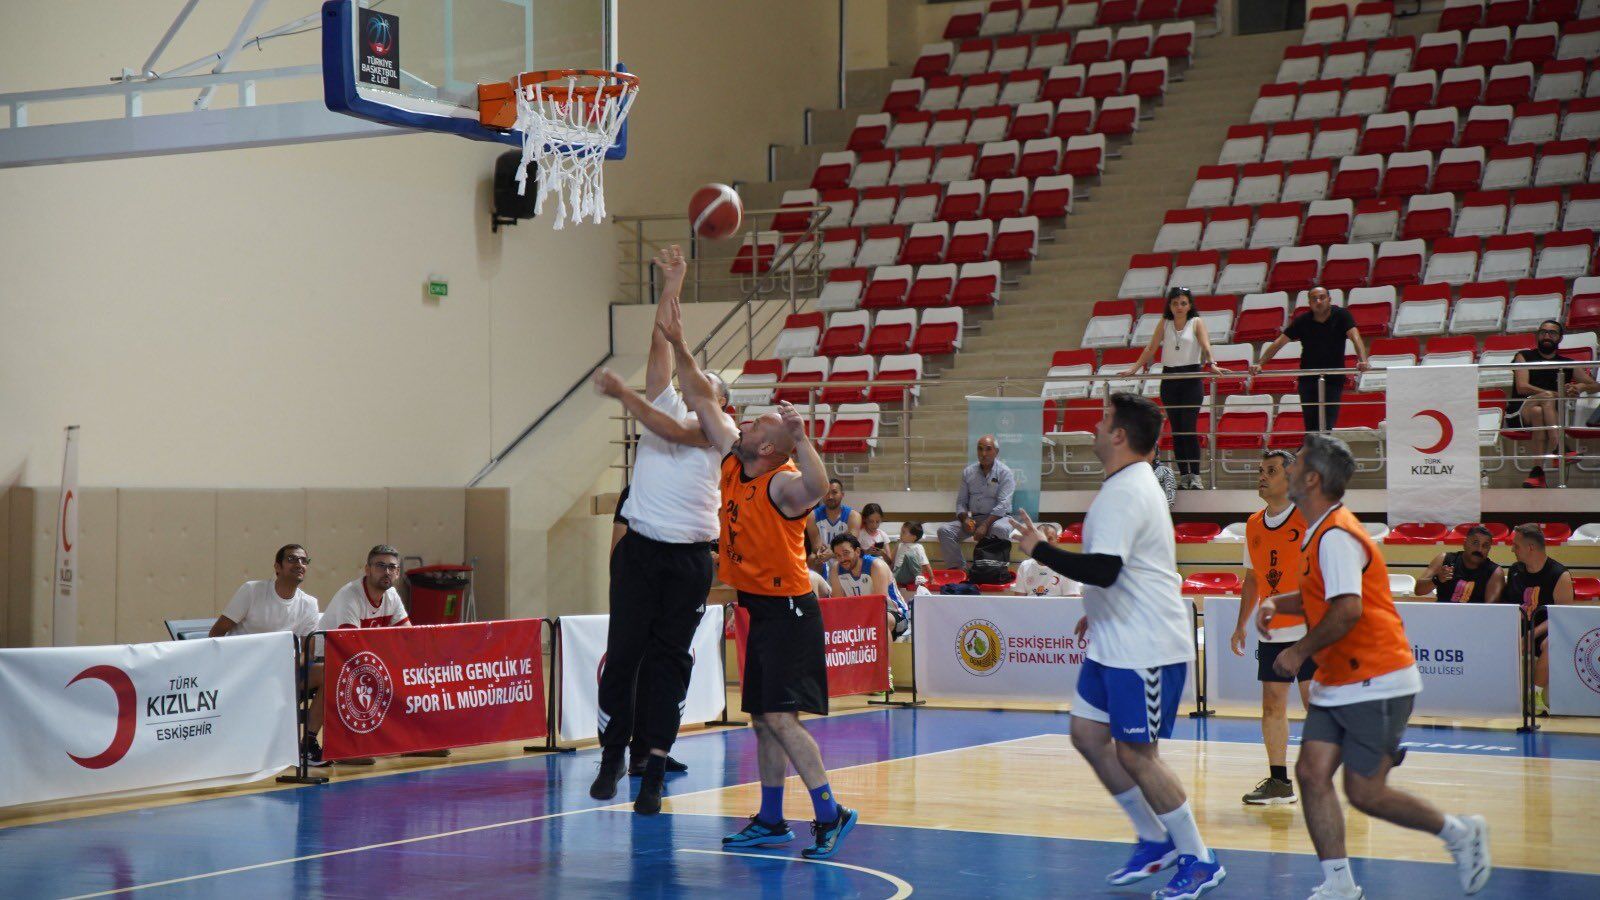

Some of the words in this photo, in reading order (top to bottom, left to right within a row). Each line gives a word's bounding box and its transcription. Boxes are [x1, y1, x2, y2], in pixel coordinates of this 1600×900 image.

[361, 63, 398, 79] BASKETBOL
[1411, 465, 1454, 475] KIZILAY
[832, 625, 865, 646] GENÇLİK
[866, 627, 877, 641] VE
[1008, 635, 1074, 652] ESKİŞEHİR
[1009, 649, 1066, 664] FİDANLIK
[1069, 651, 1087, 665] MÜ
[1434, 649, 1464, 663] OSB
[402, 661, 464, 688] ESKİŞEHİR
[466, 656, 517, 683] GENÇLİK
[520, 658, 532, 675] VE
[1418, 665, 1436, 675] OLU
[1437, 665, 1464, 676] LİSESİ
[169, 675, 199, 691] TÜRK
[146, 689, 219, 717] KIZILAY
[405, 694, 441, 714] SPOR
[442, 688, 455, 711] İL
[457, 679, 533, 709] MÜDÜRLÜĞÜ
[156, 721, 212, 741] ESKİŞEHİR
